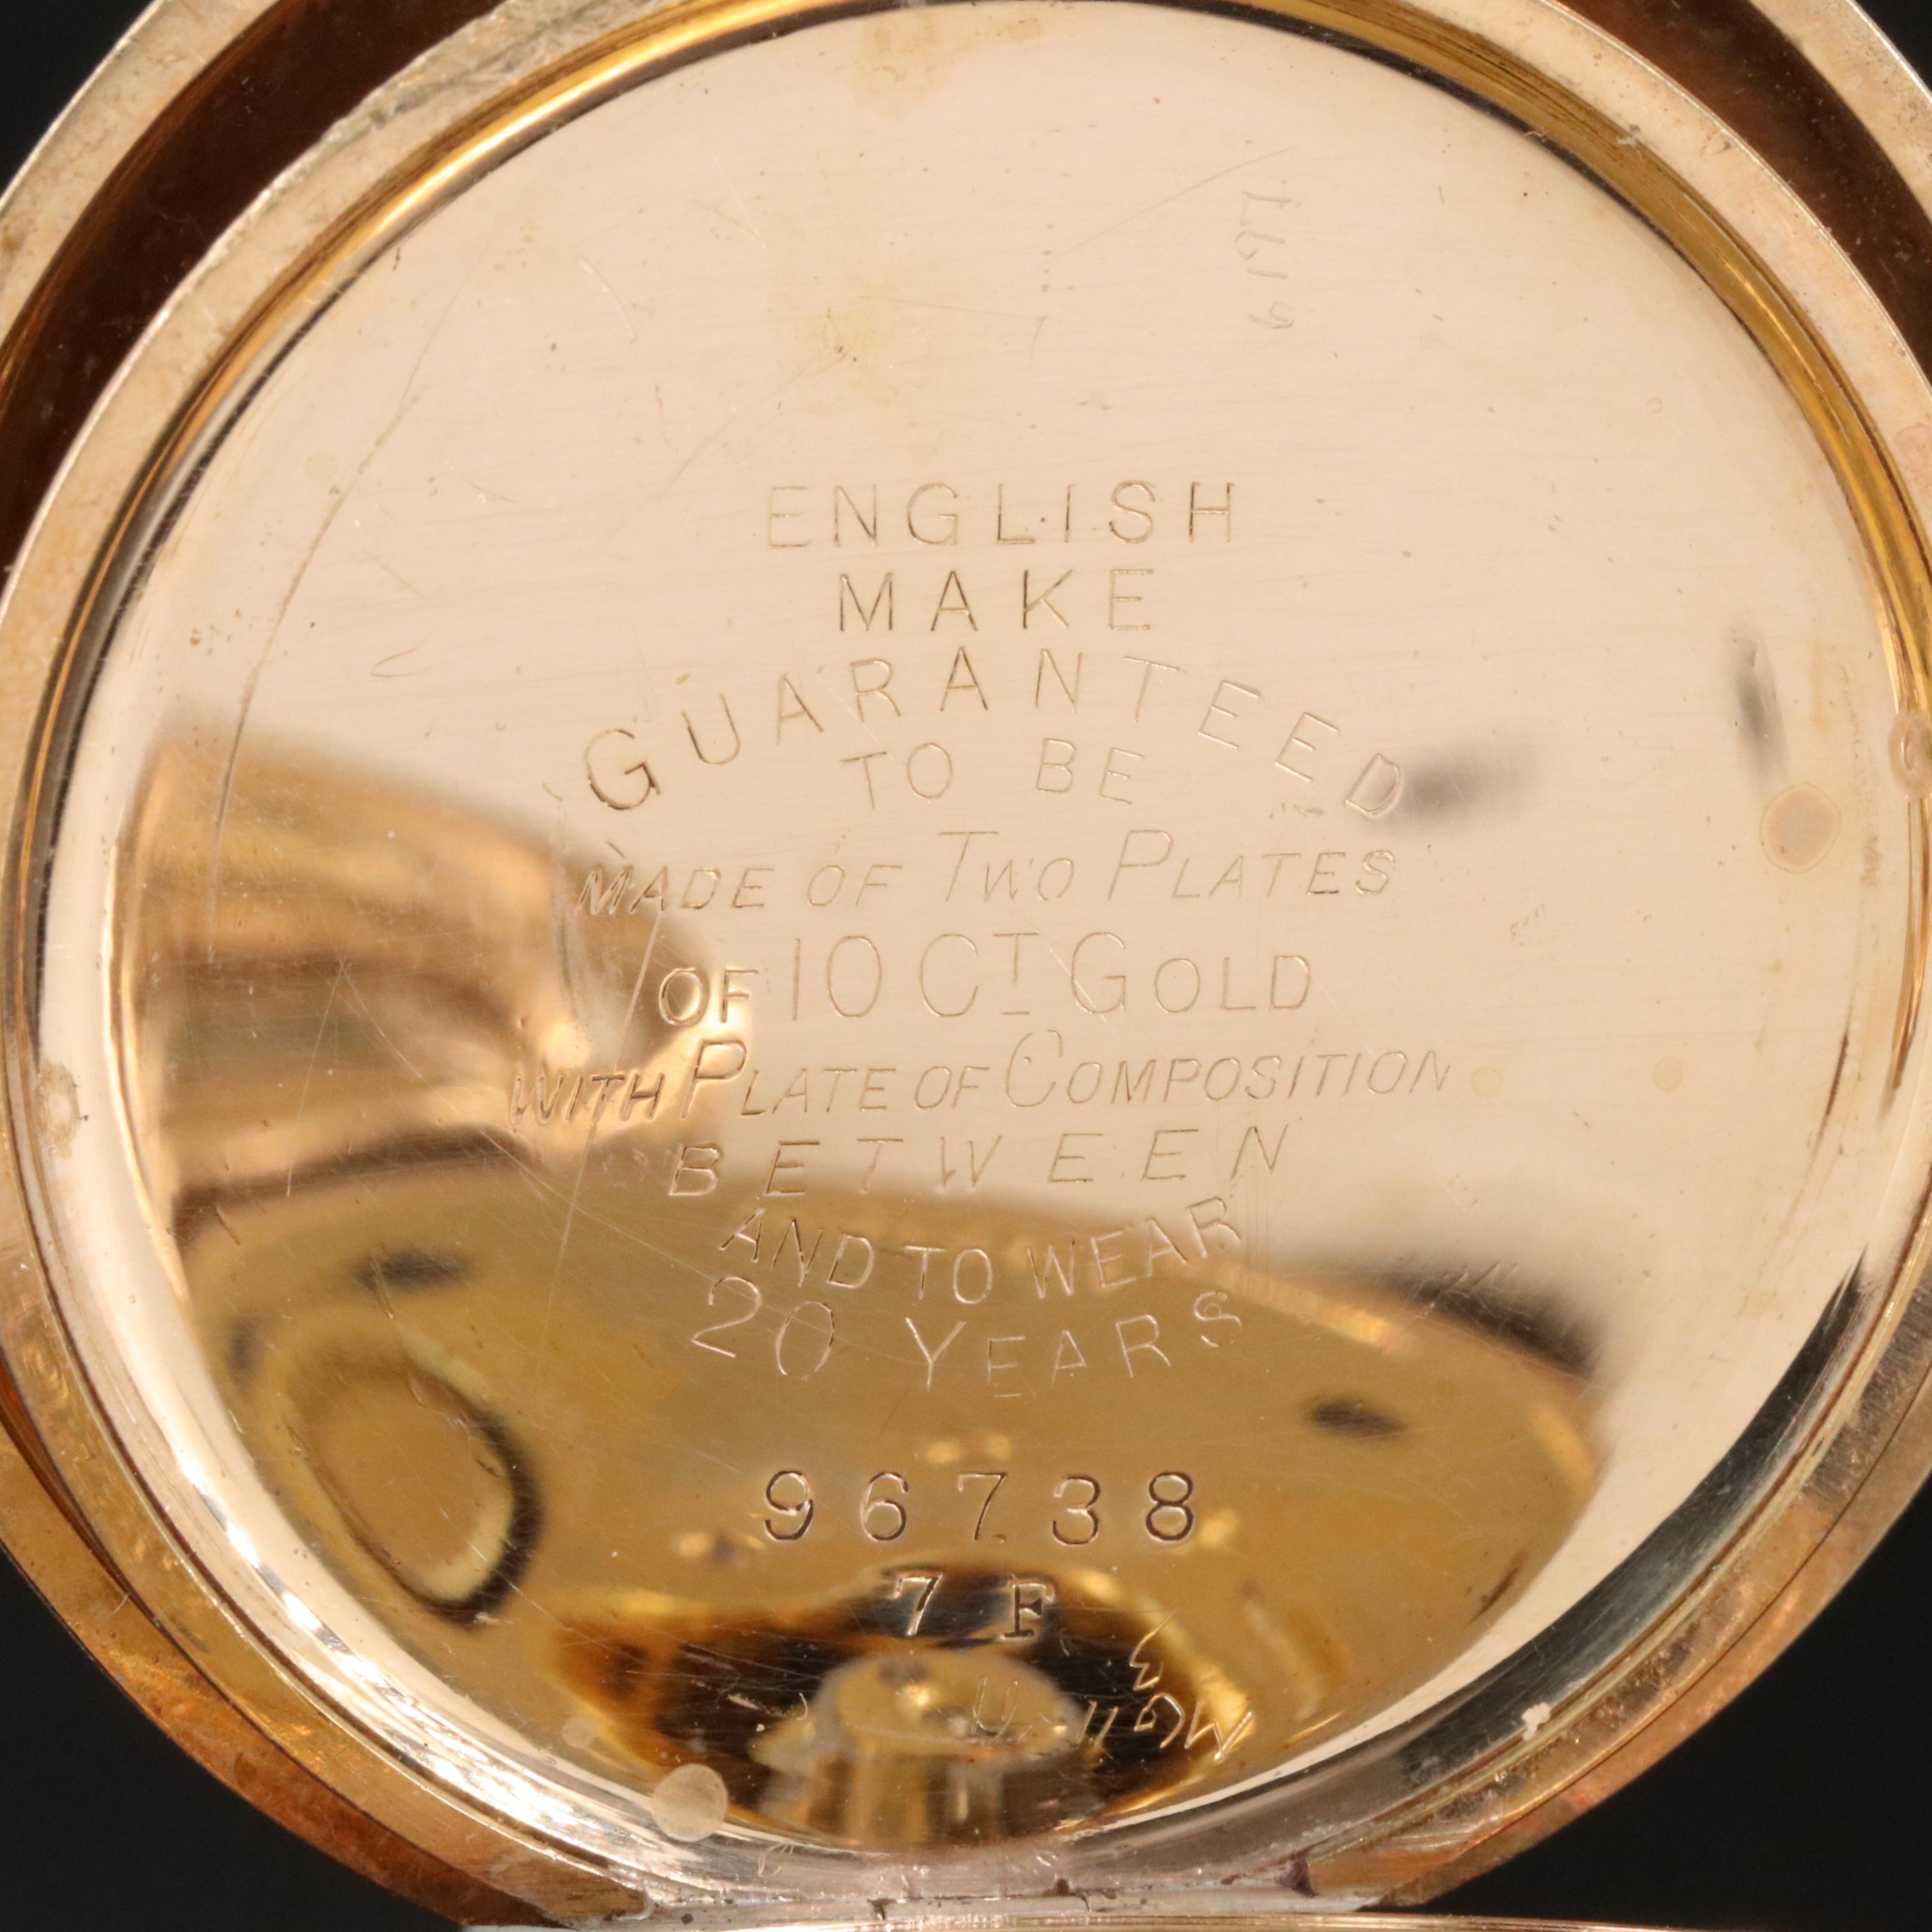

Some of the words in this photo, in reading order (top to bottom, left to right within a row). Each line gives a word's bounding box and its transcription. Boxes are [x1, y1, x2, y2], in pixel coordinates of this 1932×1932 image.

[768, 481, 1235, 548] ENGLISH
[839, 568, 1153, 632] MAKE
[583, 646, 1404, 819] GUARANTEED
[839, 742, 953, 810] TO
[1036, 738, 1144, 805] BE
[575, 864, 774, 915] MADE
[807, 865, 903, 908] OF
[1108, 829, 1396, 900] PLATES
[658, 967, 760, 1026] OF
[791, 935, 882, 1021] 10
[1070, 931, 1311, 1014] GOLD
[508, 1068, 666, 1125] WITH
[681, 1038, 896, 1120] PLATE
[914, 1066, 990, 1111] OF
[1004, 1029, 1450, 1108] COMPOSITION
[668, 1123, 1289, 1197] BETWEEN
[719, 1208, 874, 1289] AND
[904, 1245, 993, 1304] TO
[1025, 1195, 1242, 1299] WEAR
[691, 1275, 835, 1380] 20
[905, 1290, 1243, 1398] YEARS
[764, 1470, 1194, 1545] 96738
